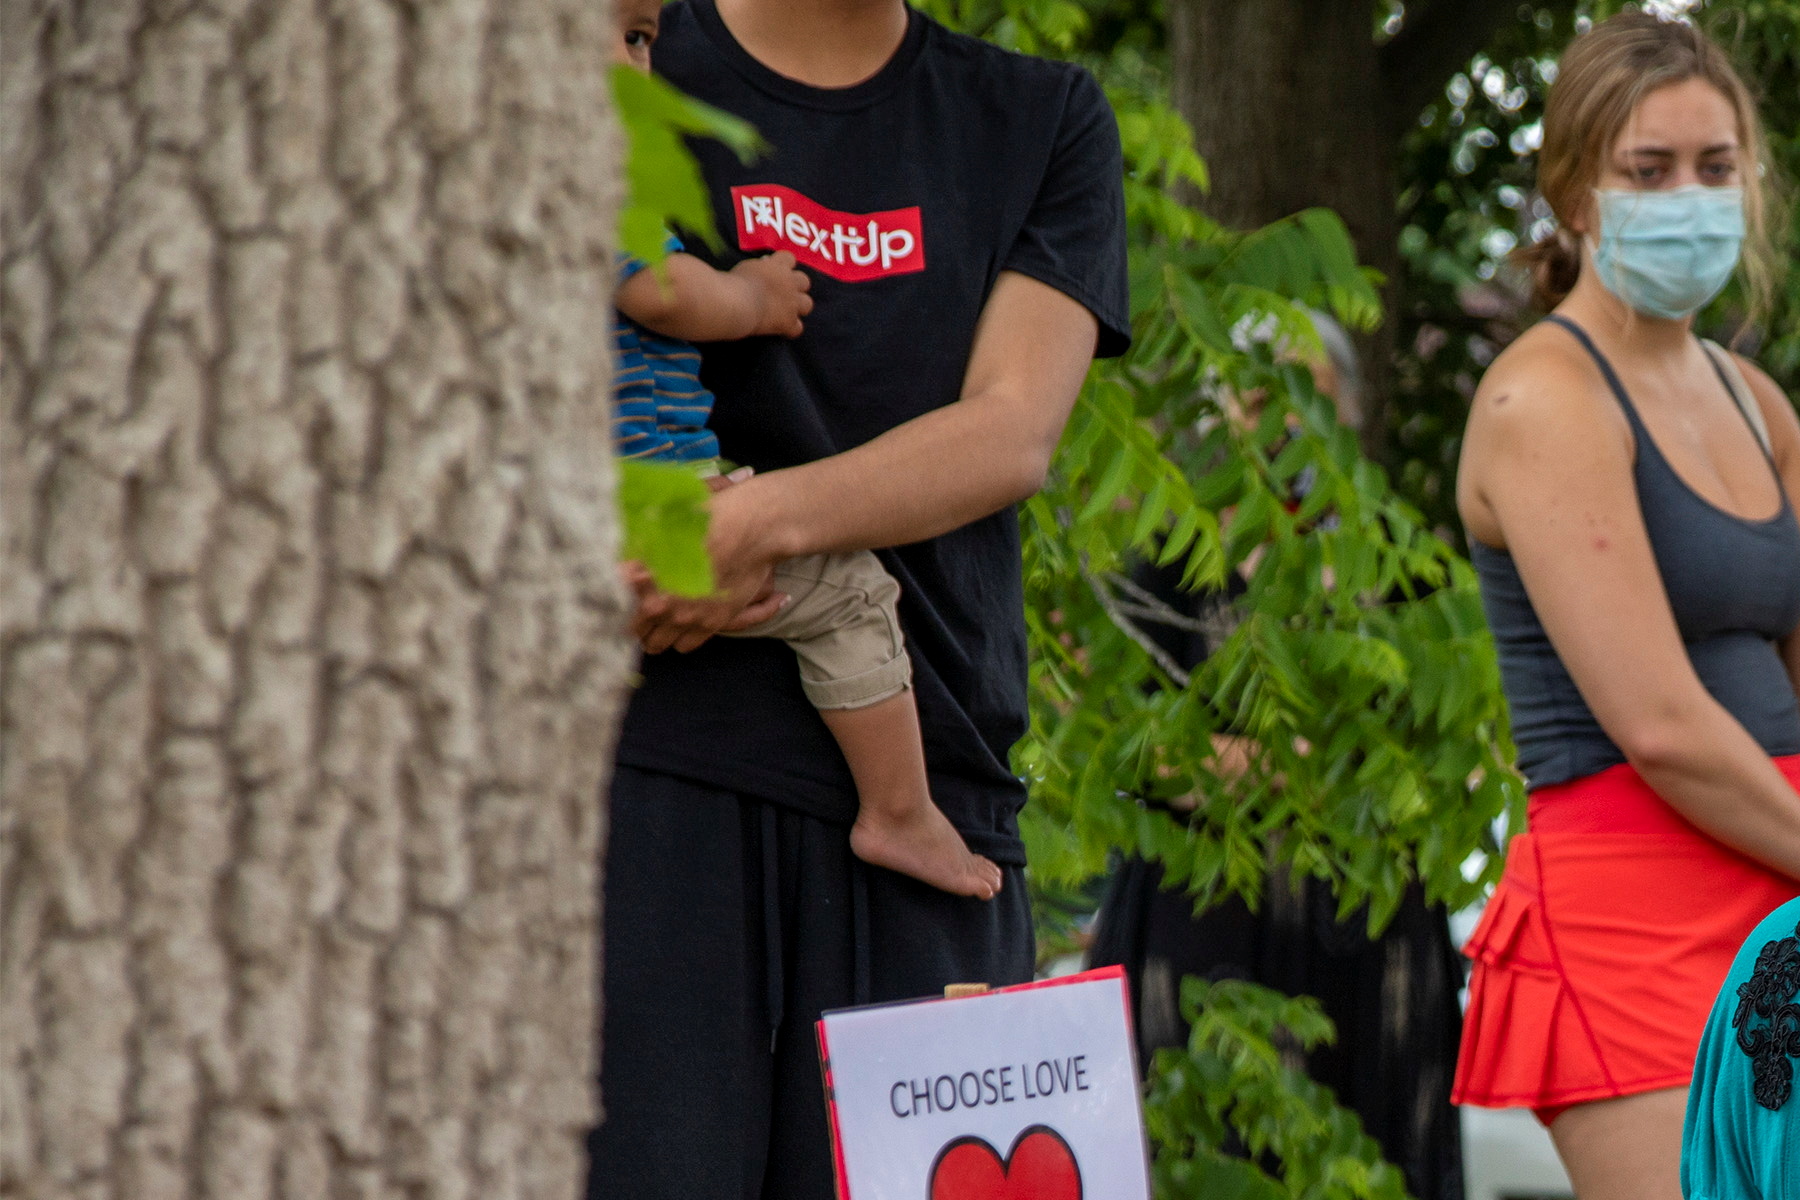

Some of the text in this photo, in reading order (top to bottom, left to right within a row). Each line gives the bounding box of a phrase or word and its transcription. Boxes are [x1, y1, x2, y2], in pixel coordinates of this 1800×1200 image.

[741, 195, 915, 270] NextUp
[889, 1055, 1090, 1118] CHOOSE LOVE
